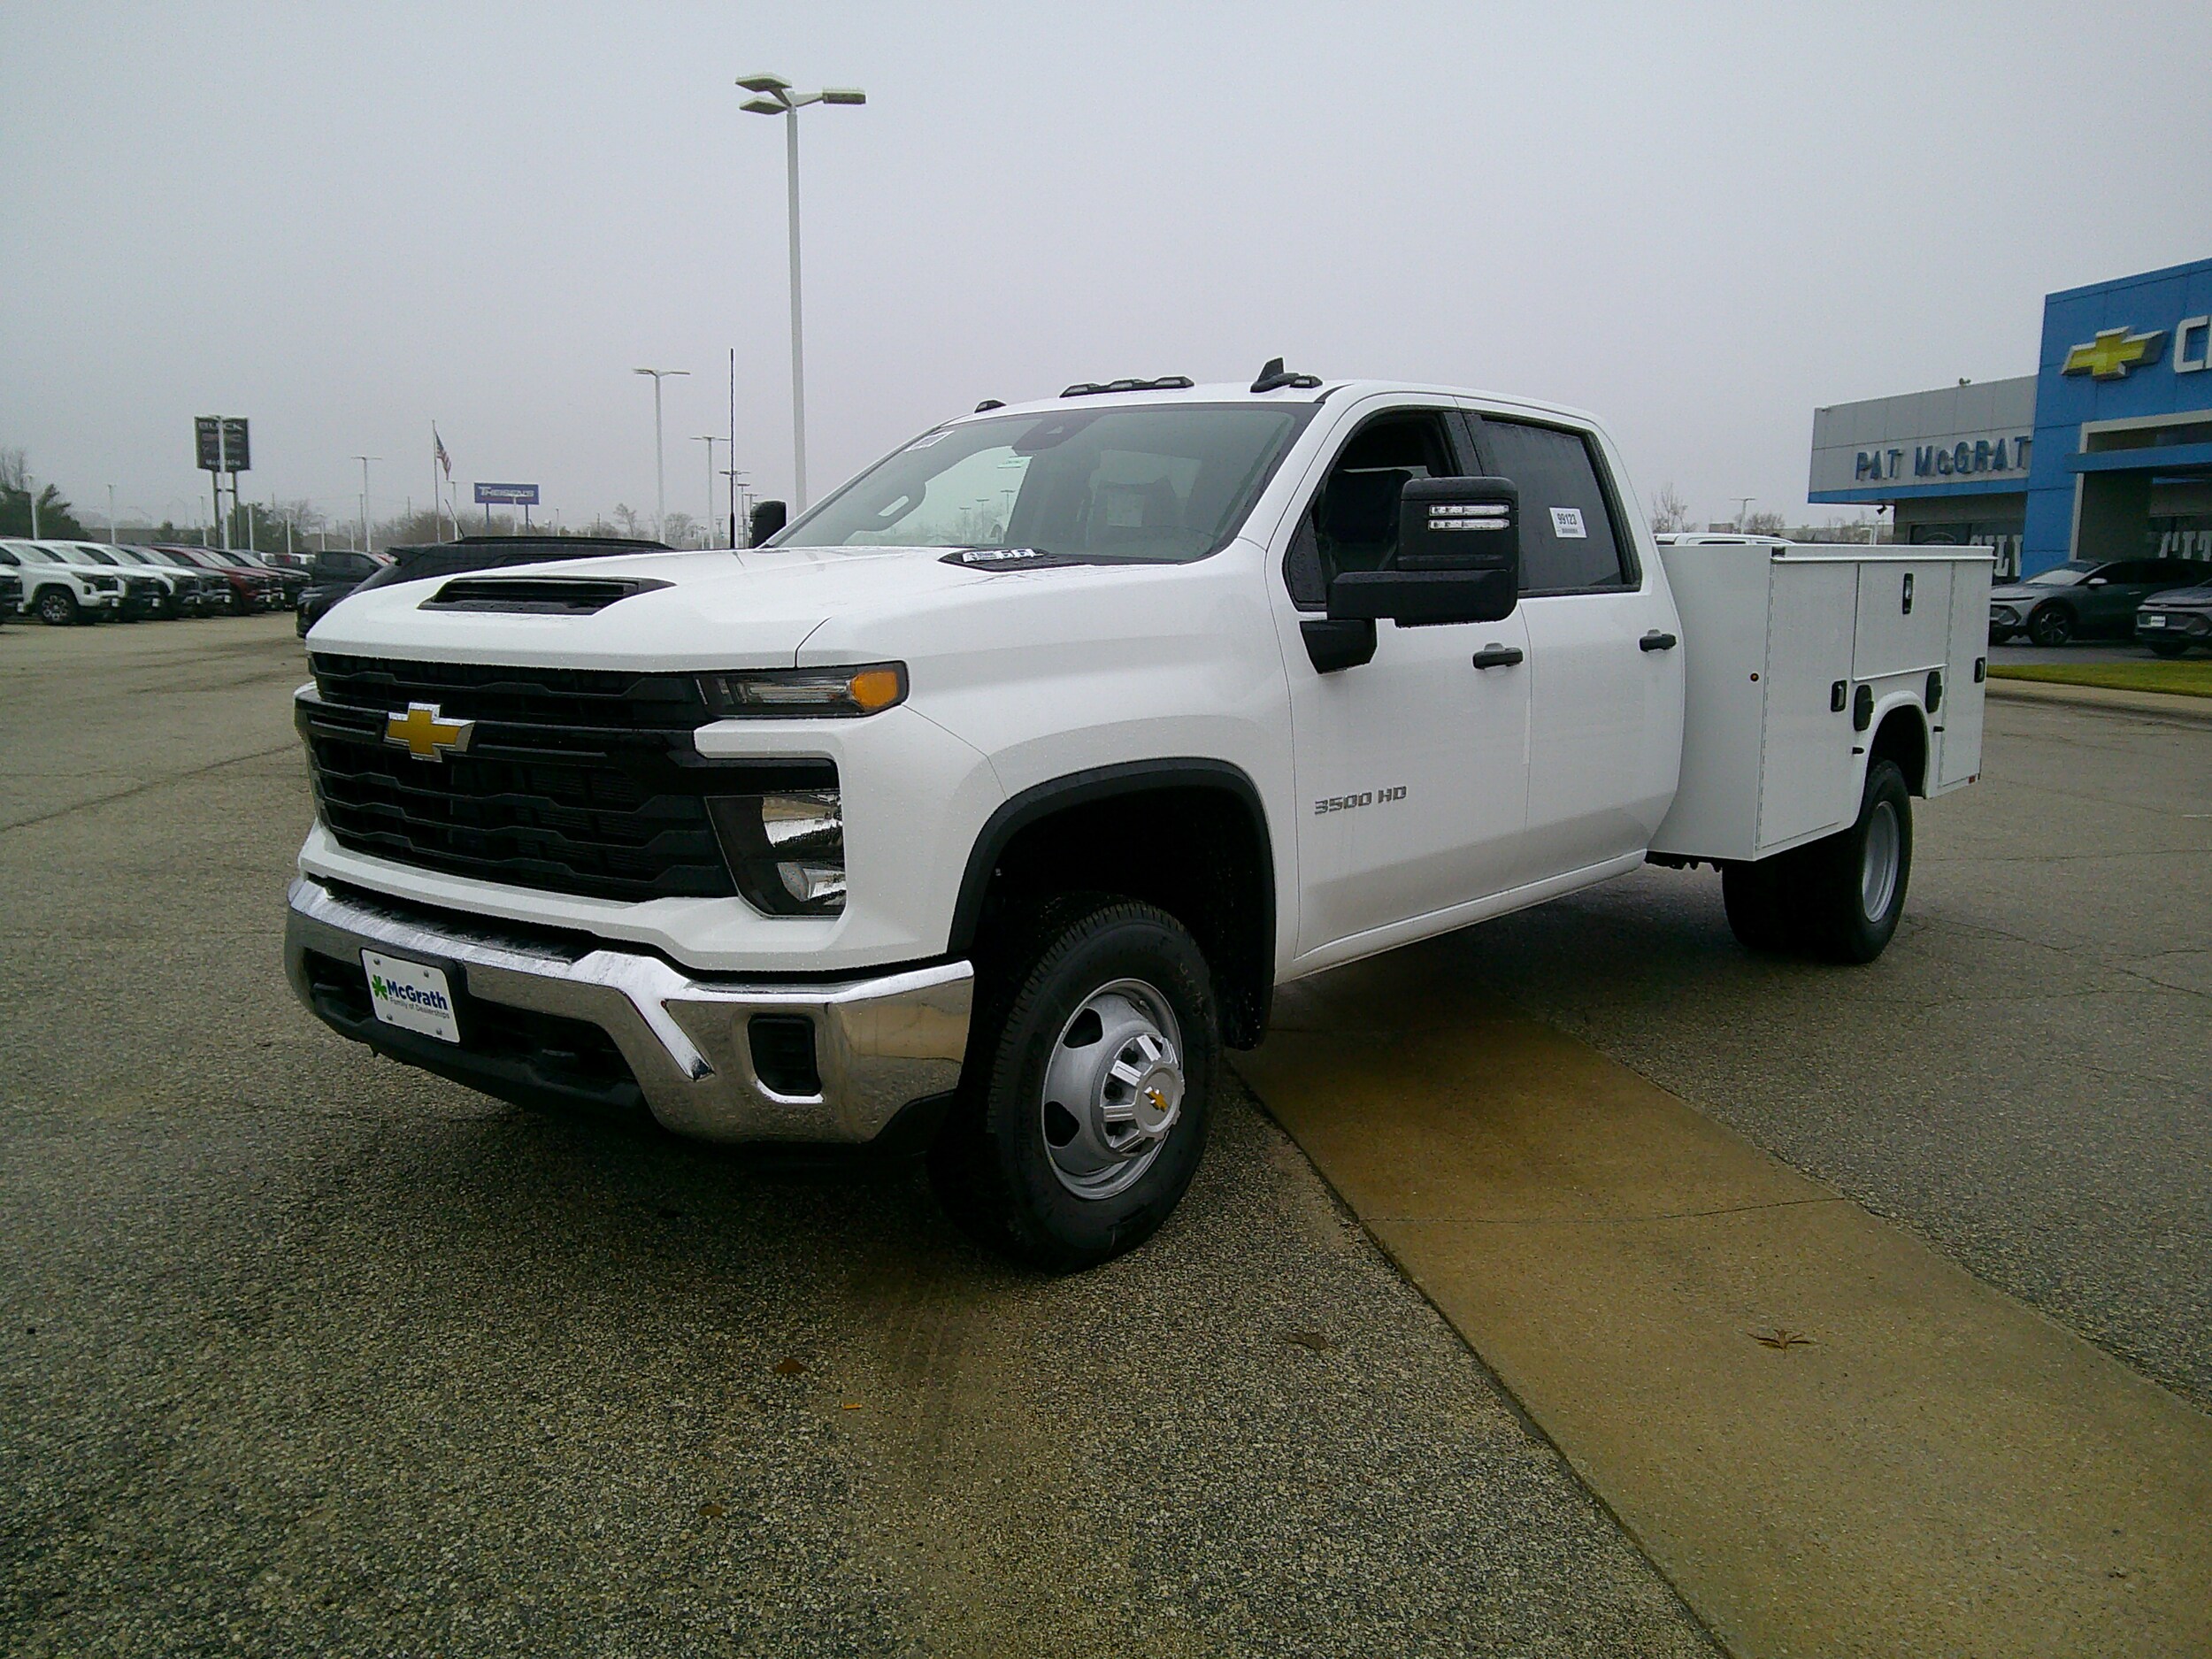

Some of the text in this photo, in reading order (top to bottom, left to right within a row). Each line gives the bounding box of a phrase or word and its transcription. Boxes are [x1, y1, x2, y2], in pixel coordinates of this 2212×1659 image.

[2174, 314, 2212, 373] C
[1855, 448, 1903, 481] PAT
[1557, 512, 1578, 526] 99123
[1314, 785, 1407, 816] 3500 HD
[386, 979, 449, 1011] McGrath
[389, 996, 409, 1010] Family
[415, 1003, 450, 1020] Dealerships
